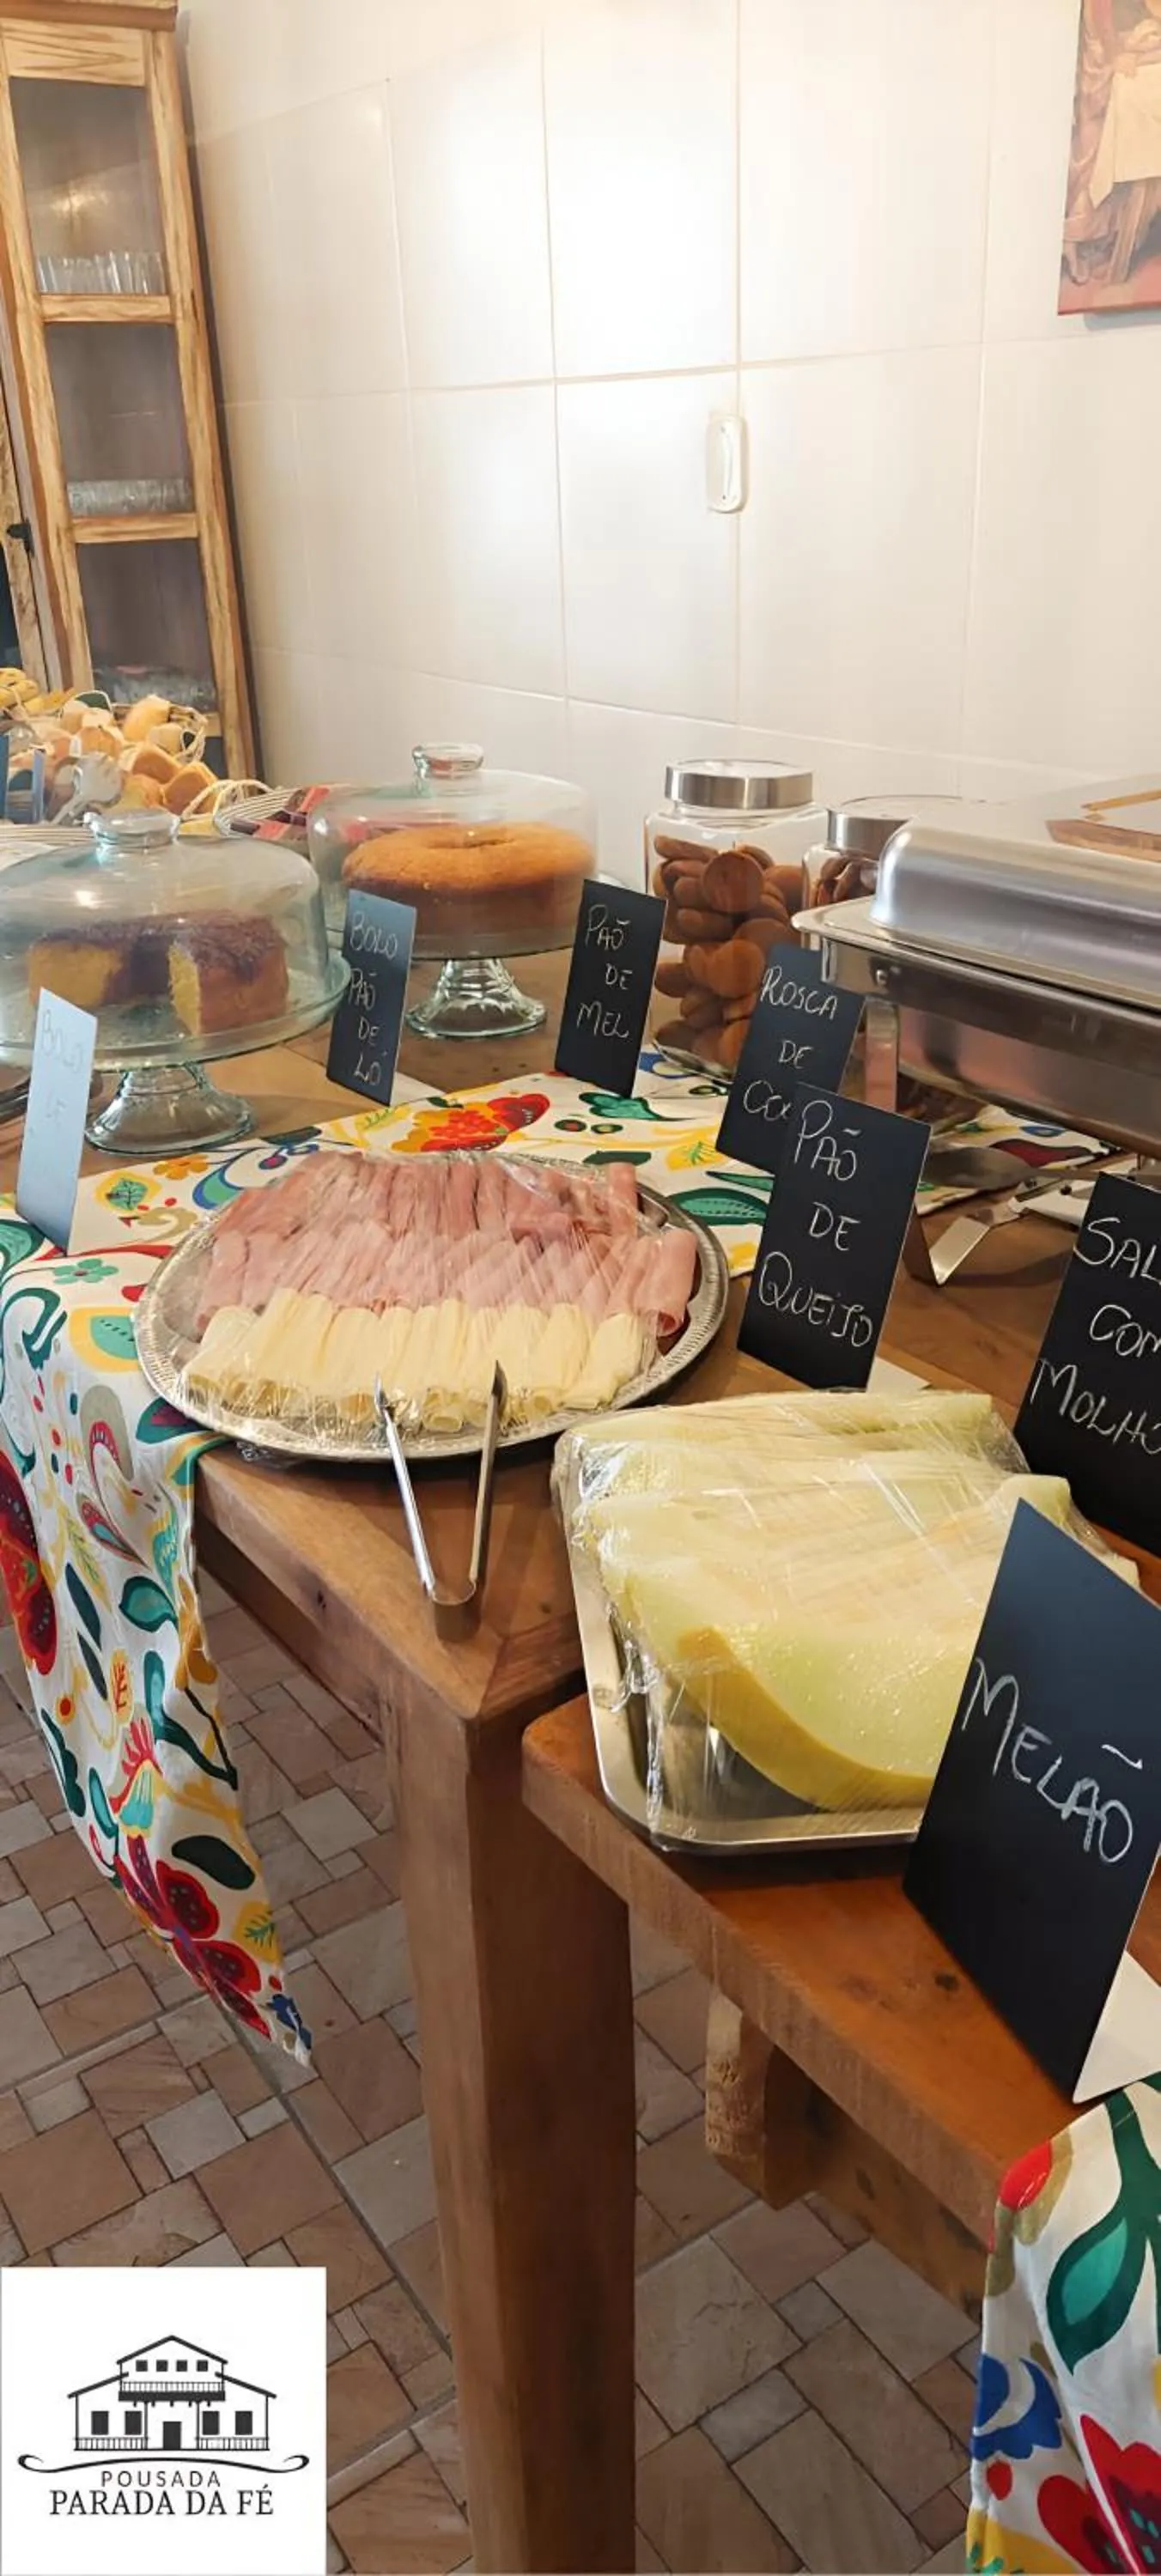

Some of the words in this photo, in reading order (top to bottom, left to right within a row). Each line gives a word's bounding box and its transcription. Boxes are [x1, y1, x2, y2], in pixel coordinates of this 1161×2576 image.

[605, 963, 633, 991] DE
[759, 965, 839, 1022] ROSCA
[359, 1016, 380, 1046] DE
[576, 1000, 629, 1038] MEL
[778, 1039, 815, 1069] DE
[807, 1202, 860, 1252] DE
